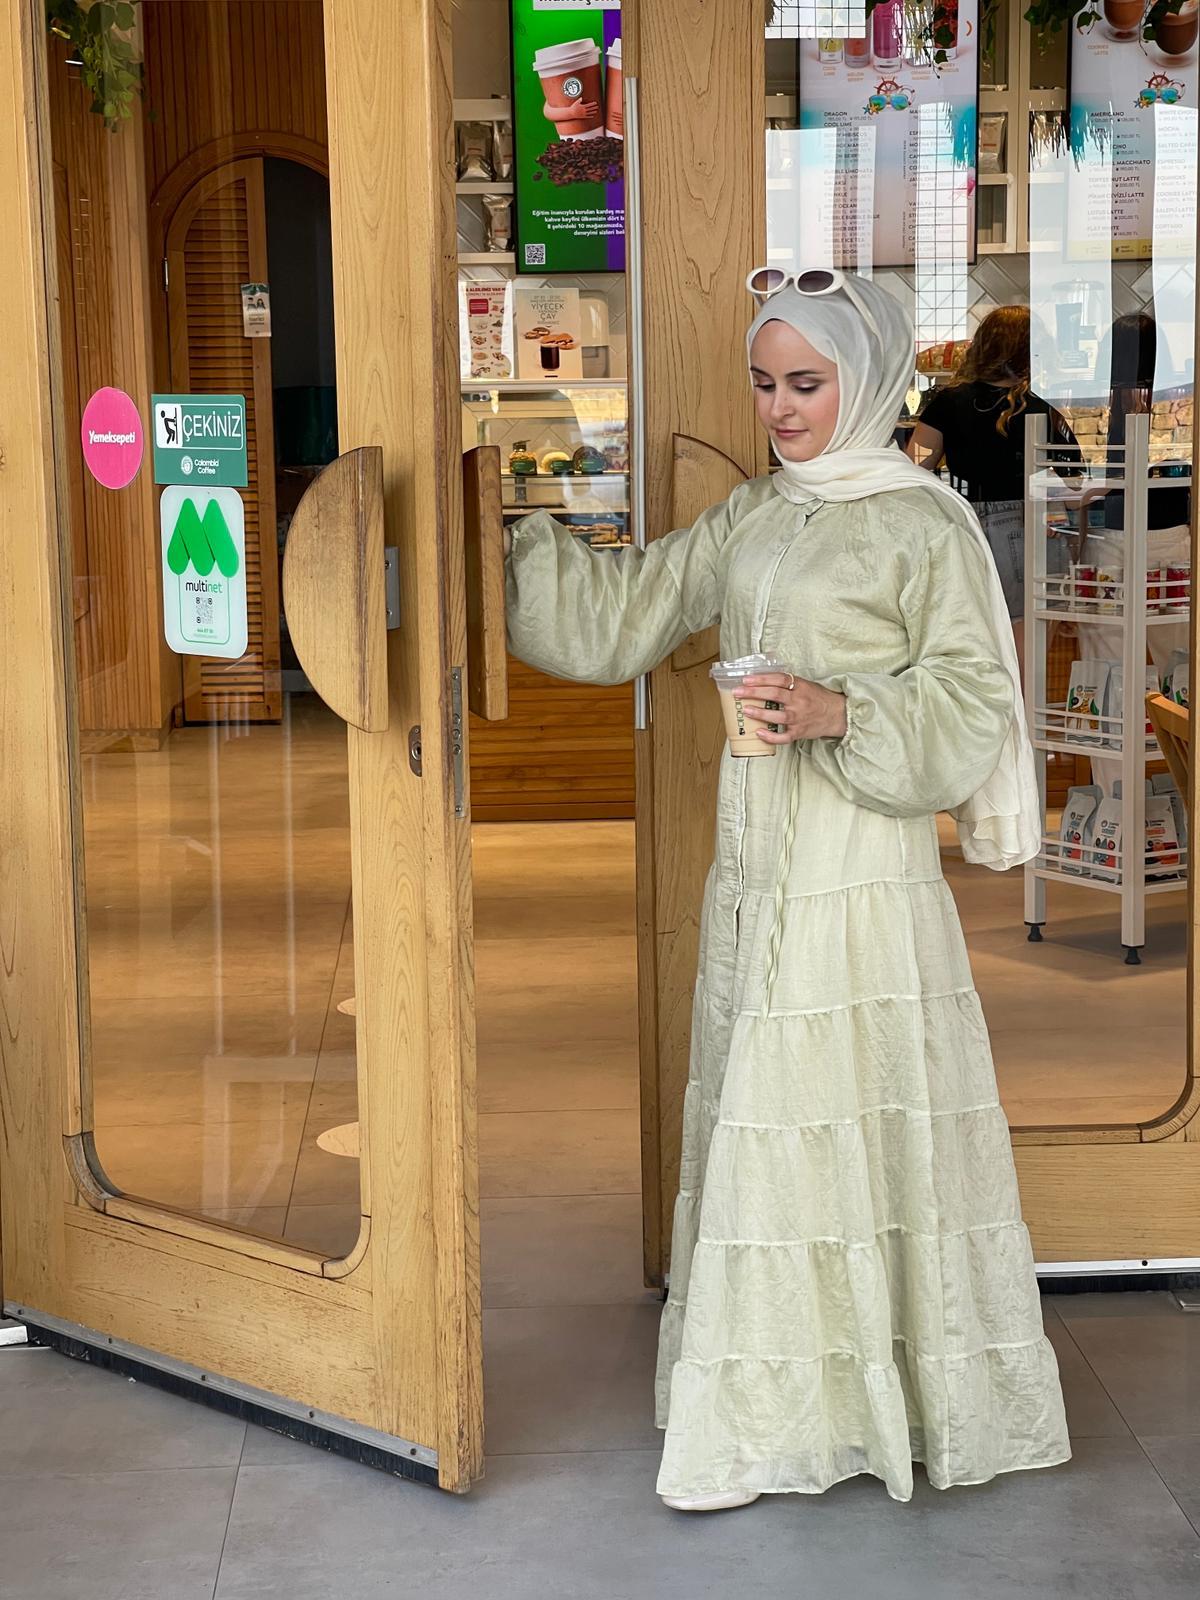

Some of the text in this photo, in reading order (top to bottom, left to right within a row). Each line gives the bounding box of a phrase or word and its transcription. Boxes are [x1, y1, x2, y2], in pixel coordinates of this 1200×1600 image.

[531, 302, 565, 311] YİYECEK
[540, 312, 556, 320] ÇAY
[183, 410, 242, 442] ÇEKİNİZ
[88, 430, 136, 446] Yemeksepeti
[194, 459, 219, 467] Colombia
[197, 466, 216, 475] Coffee
[185, 579, 223, 594] multinet
